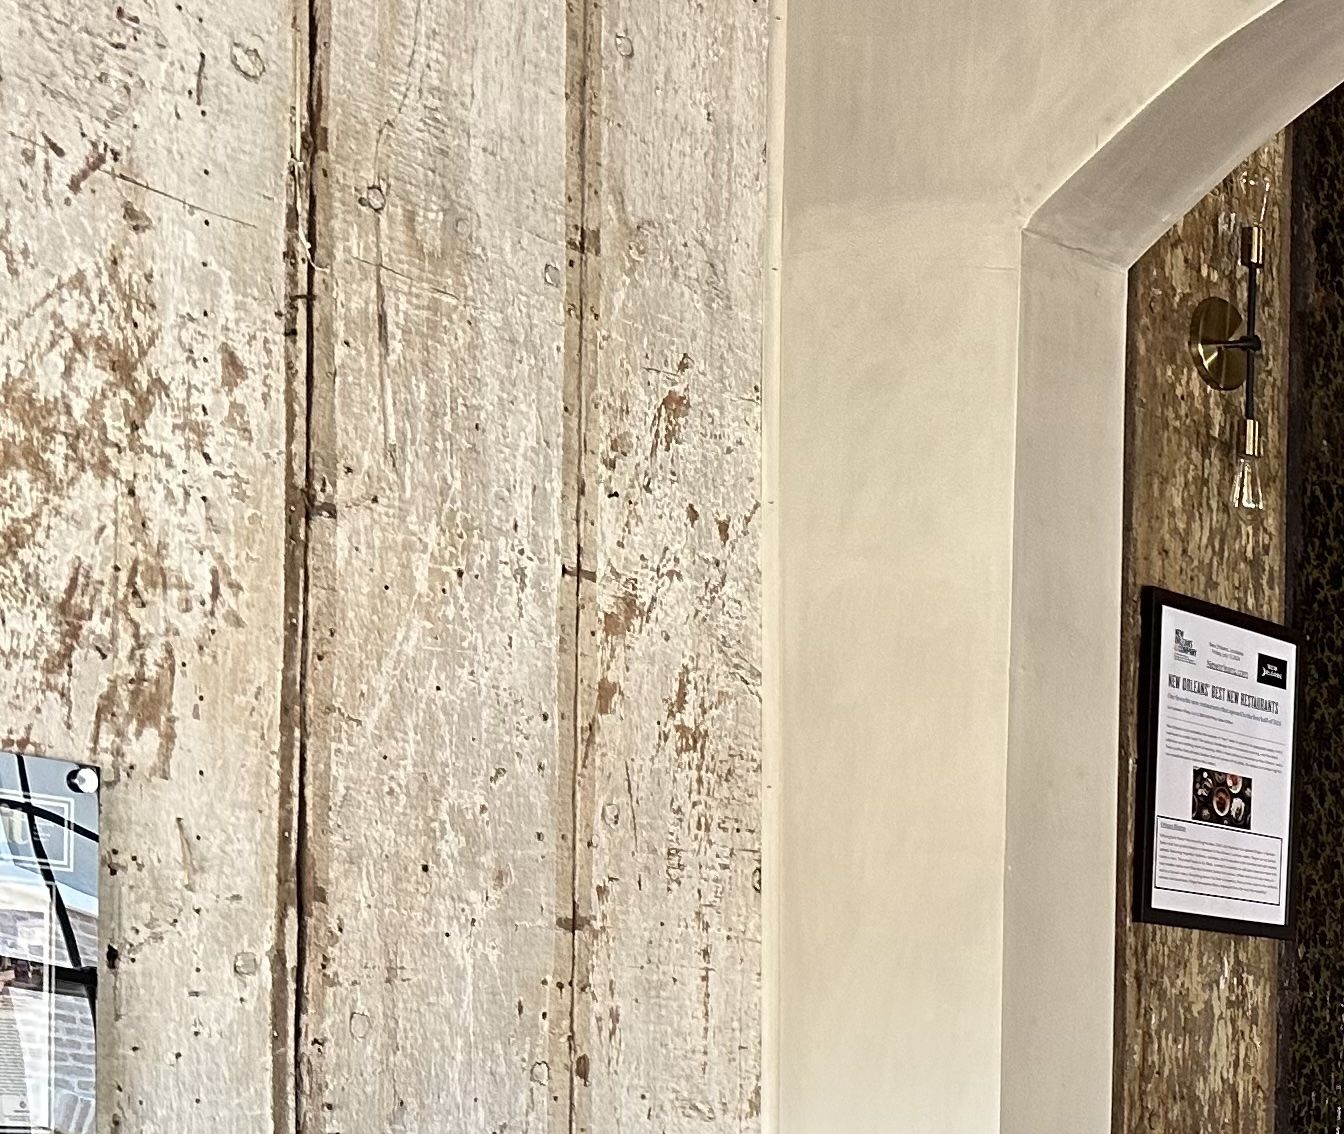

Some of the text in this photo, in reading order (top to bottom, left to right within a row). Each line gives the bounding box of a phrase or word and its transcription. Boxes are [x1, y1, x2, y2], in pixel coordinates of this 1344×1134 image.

[1167, 674, 1181, 689] NEW
[1211, 685, 1226, 702] BEST
[1226, 689, 1240, 705] NEW
[1240, 693, 1279, 715] RESTAURANTS
